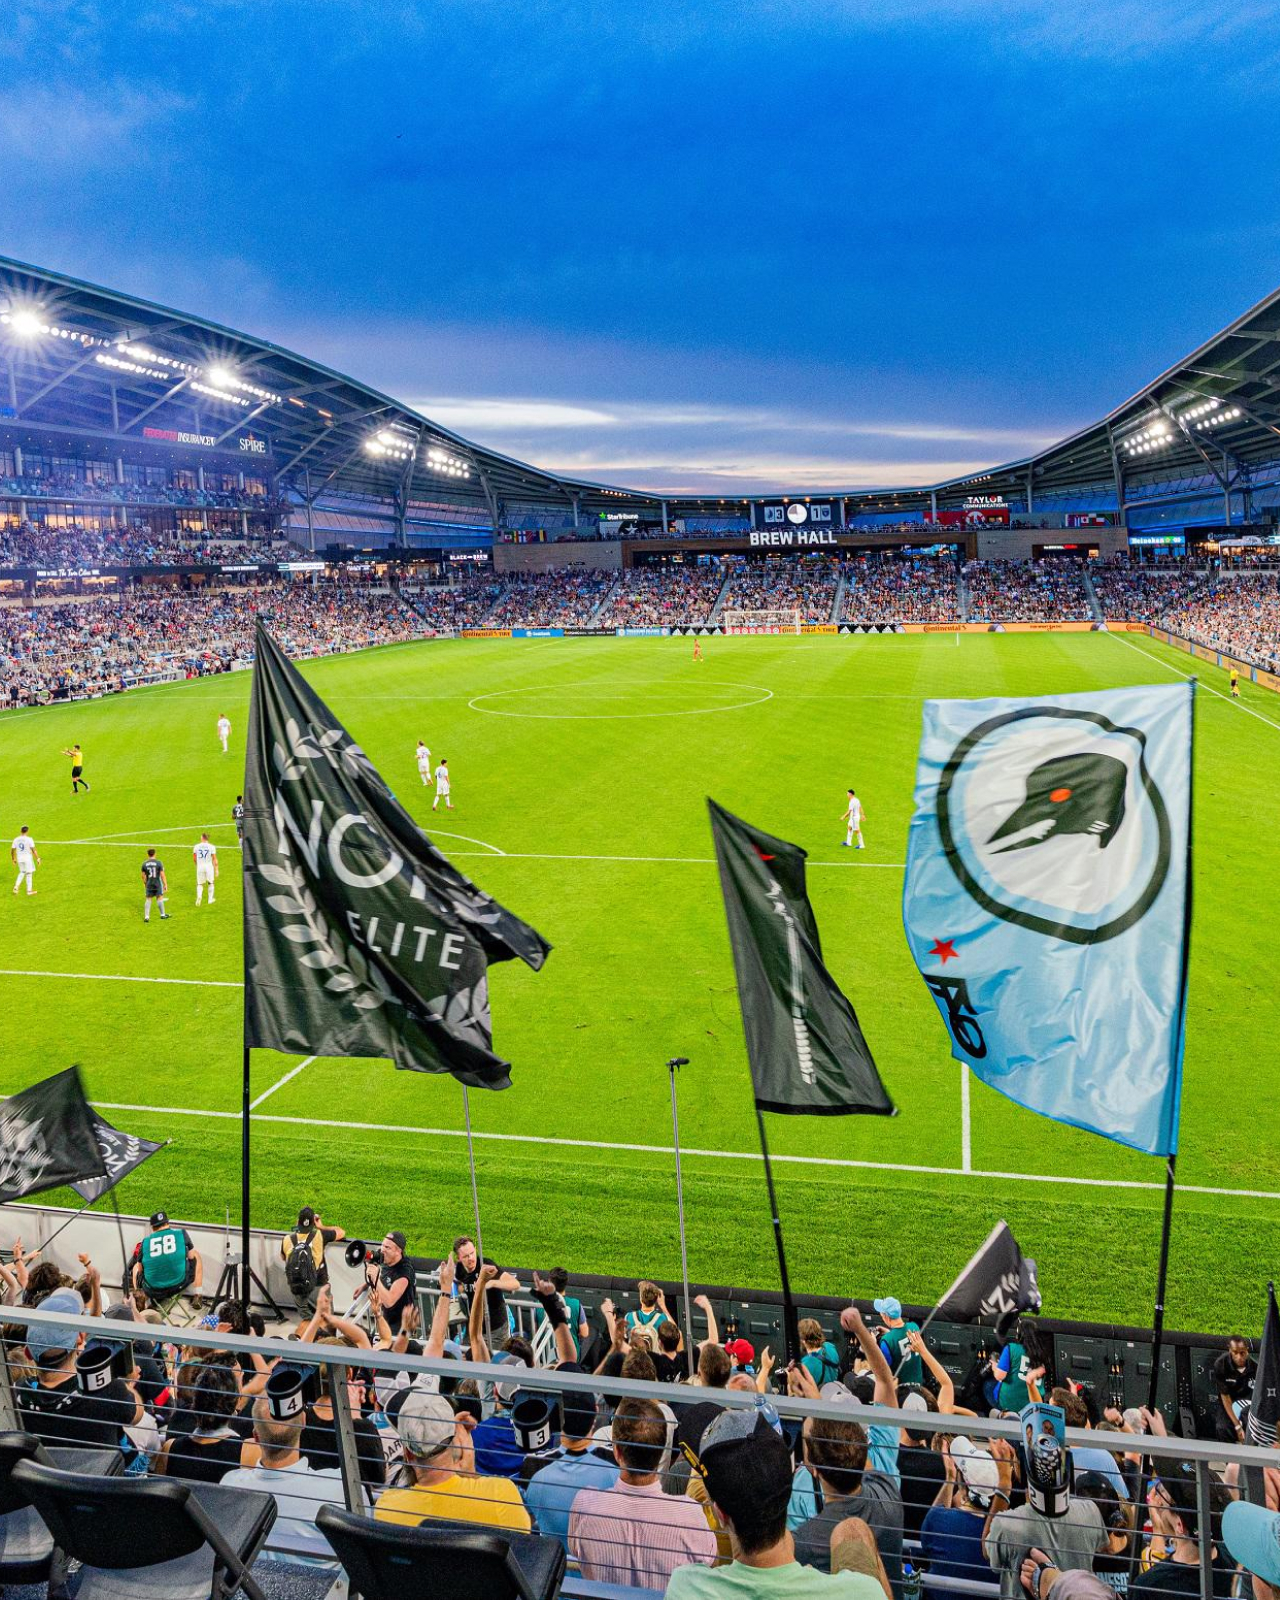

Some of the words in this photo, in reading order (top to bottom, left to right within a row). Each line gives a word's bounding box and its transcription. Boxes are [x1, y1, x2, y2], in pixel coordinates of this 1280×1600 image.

[239, 438, 266, 453] SPIRE
[776, 509, 783, 519] 3
[813, 508, 819, 518] 1
[750, 531, 793, 546] BREW
[797, 530, 838, 545] HALL
[923, 624, 961, 633] Continental
[18, 842, 25, 851] 9
[198, 849, 209, 859] 37
[147, 866, 156, 878] 31
[345, 910, 466, 971] ELITE
[150, 1234, 177, 1257] 58
[95, 1374, 105, 1387] 5
[286, 1397, 298, 1413] 4
[536, 1429, 546, 1446] 3
